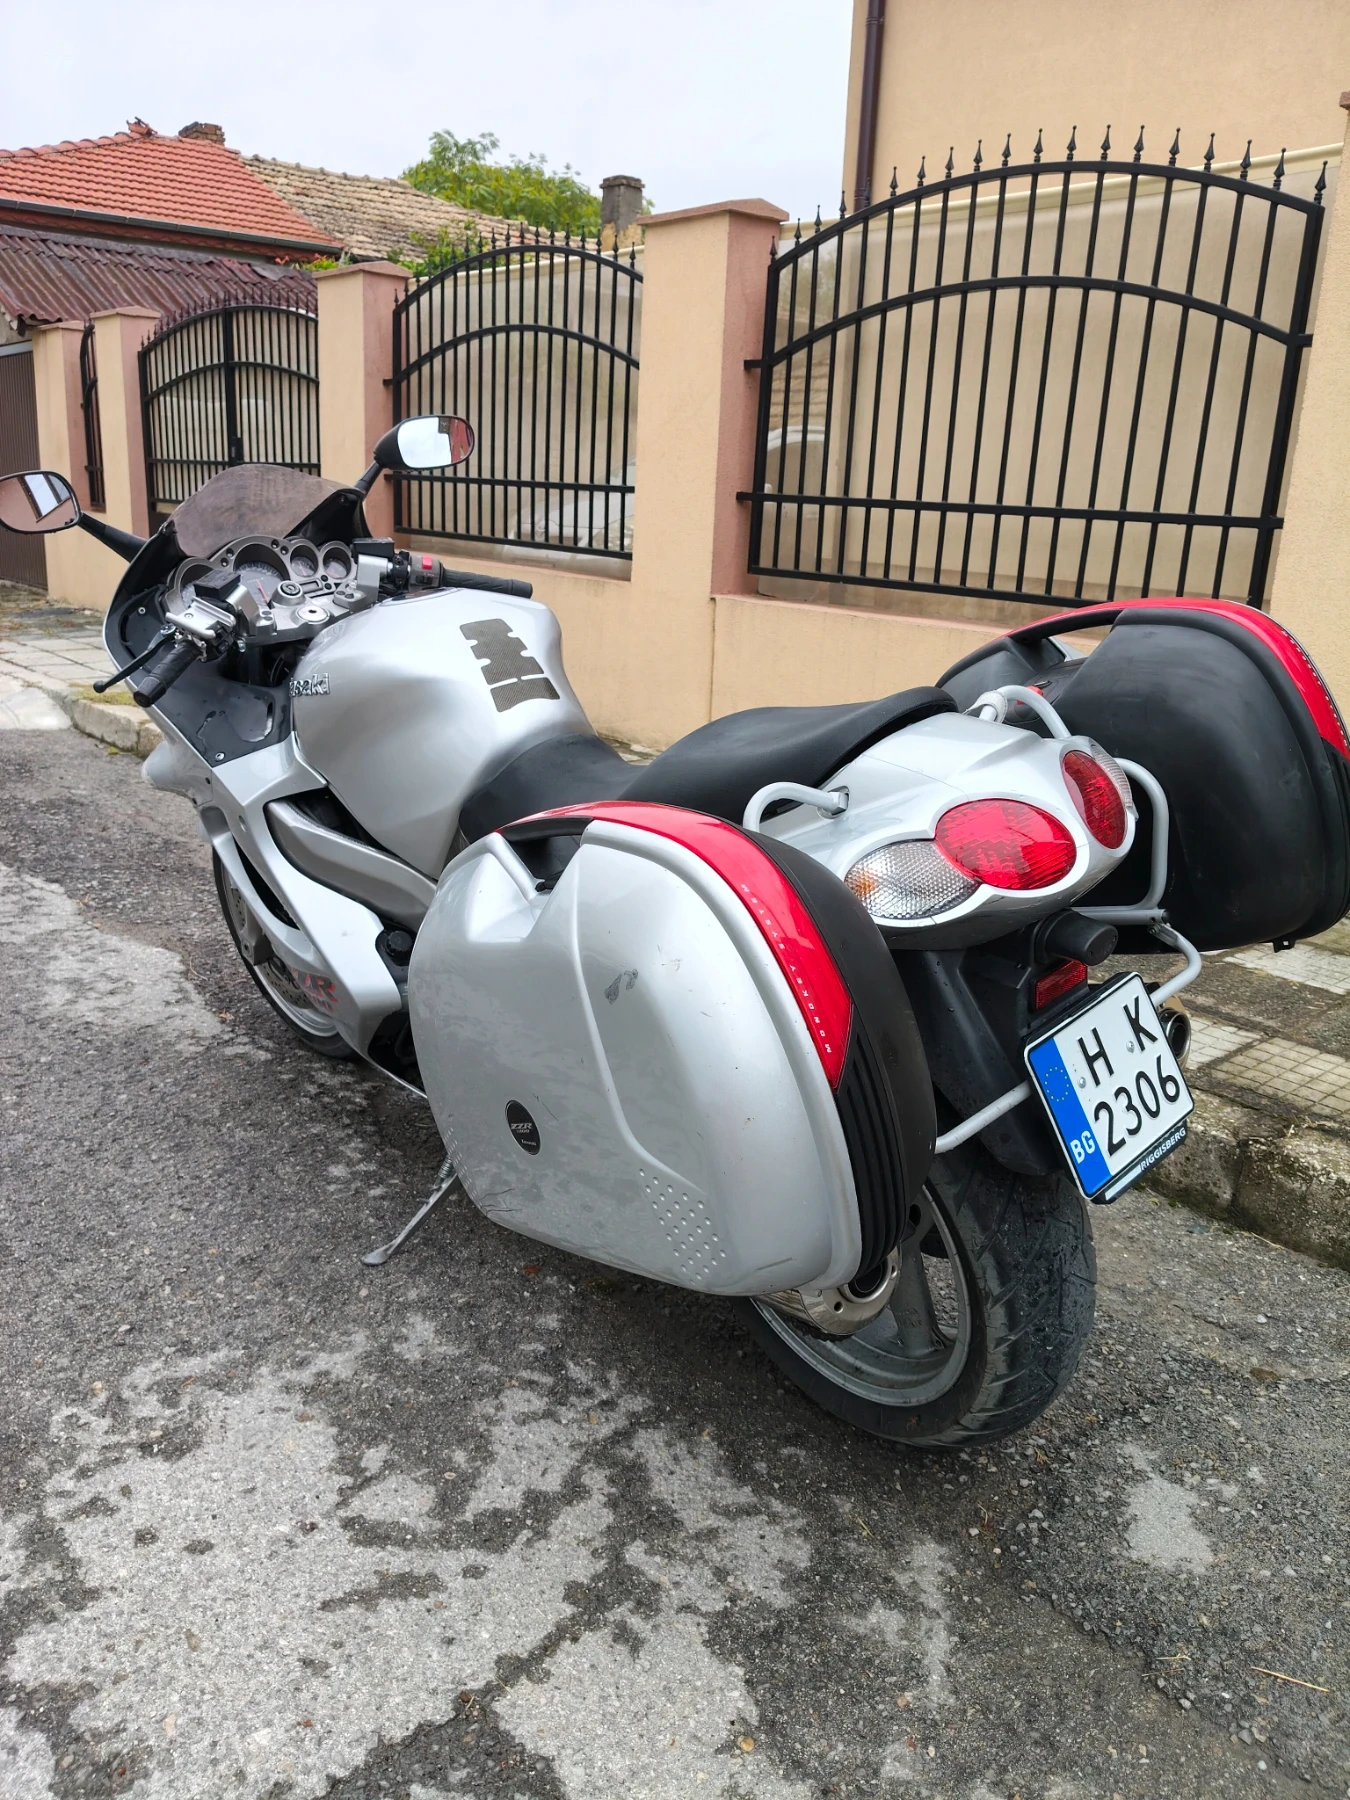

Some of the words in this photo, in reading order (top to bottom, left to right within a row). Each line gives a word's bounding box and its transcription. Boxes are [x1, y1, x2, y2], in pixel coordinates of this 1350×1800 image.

[741, 884, 786, 950] SYSTEM
[1077, 1027, 1114, 1087] H
[1123, 995, 1158, 1052] K
[1094, 1054, 1180, 1157] 2306
[1070, 1130, 1096, 1164] BG
[1140, 1127, 1187, 1171] RIGGISBERG
